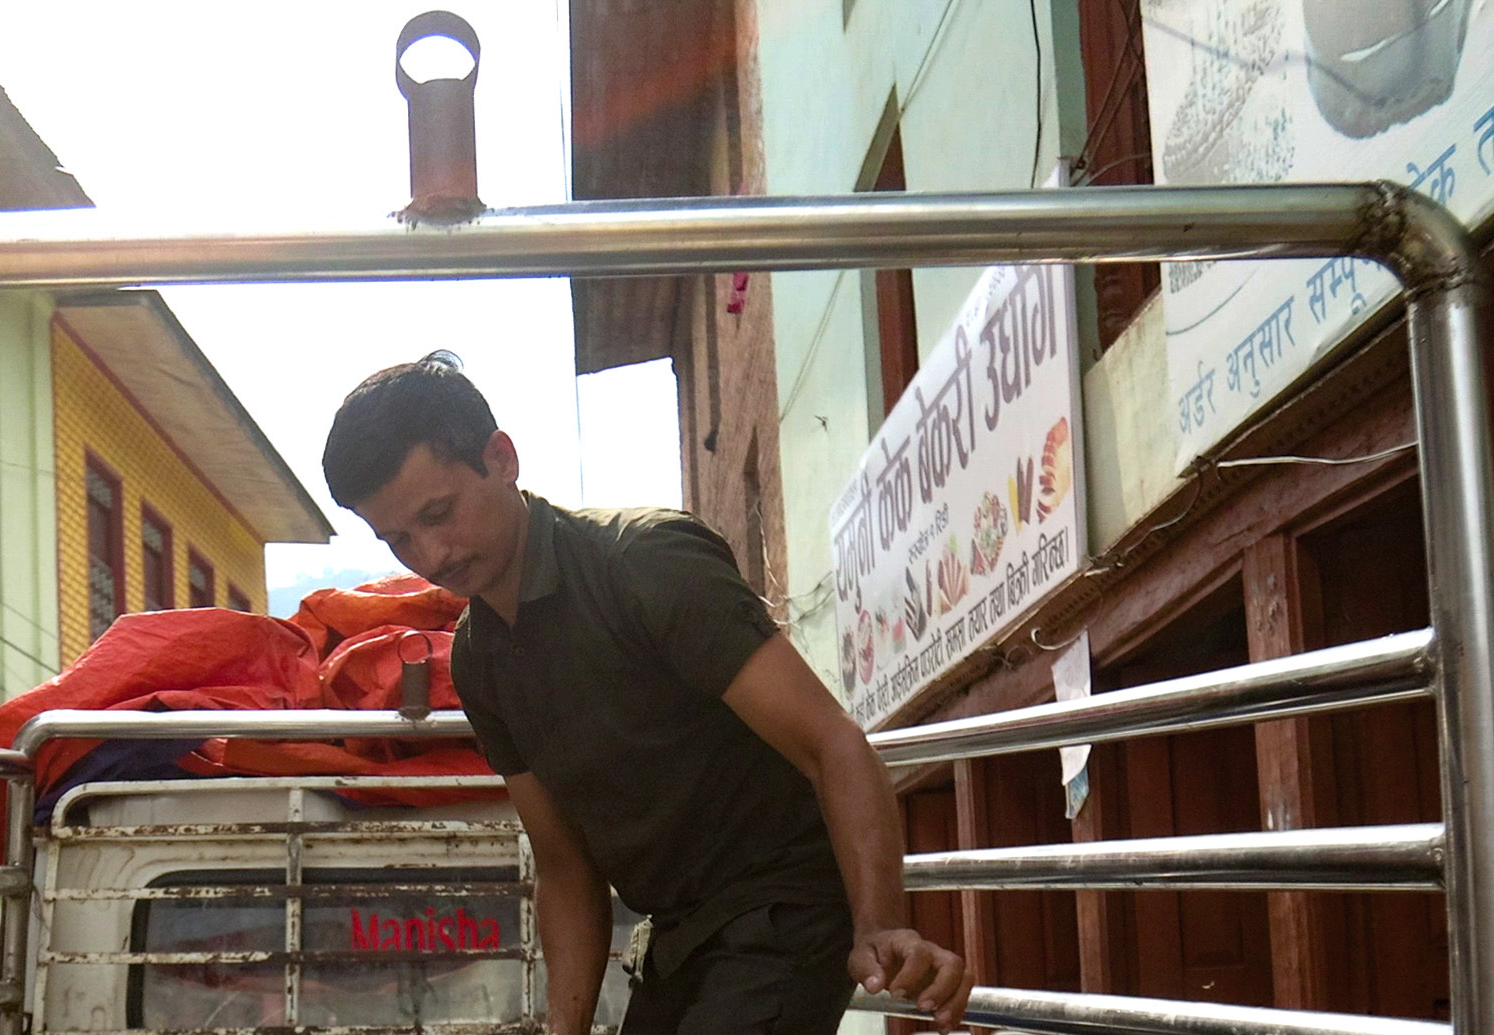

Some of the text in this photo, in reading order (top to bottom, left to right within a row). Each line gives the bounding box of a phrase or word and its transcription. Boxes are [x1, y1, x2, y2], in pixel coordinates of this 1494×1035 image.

[1178, 360, 1216, 435] अर्डर
[1226, 295, 1296, 399] अनुसार
[876, 434, 912, 551] केक
[915, 324, 976, 504] बेकरी
[350, 906, 500, 951] Manisha
